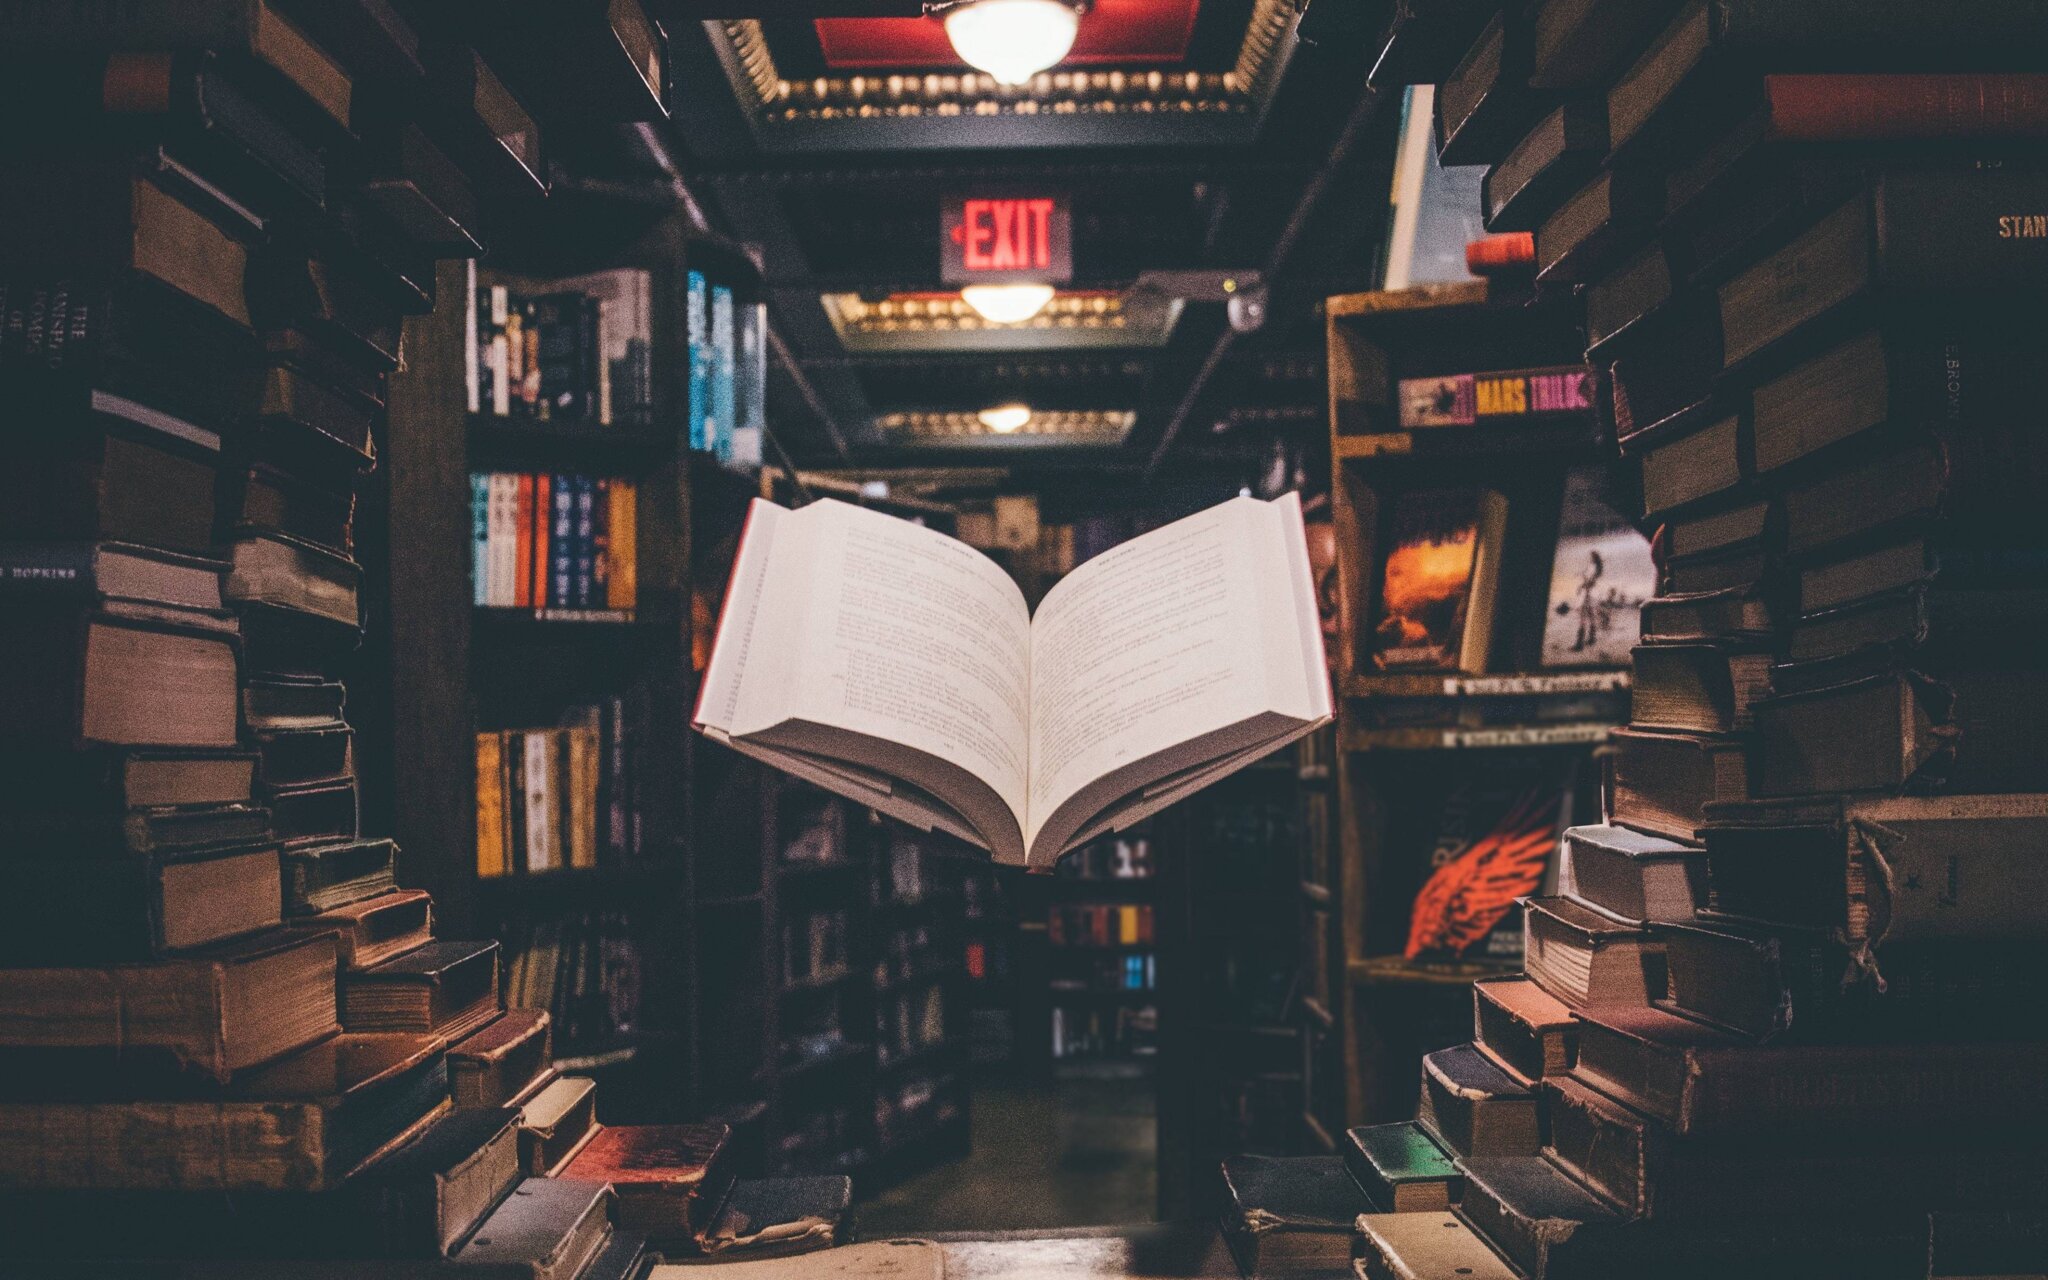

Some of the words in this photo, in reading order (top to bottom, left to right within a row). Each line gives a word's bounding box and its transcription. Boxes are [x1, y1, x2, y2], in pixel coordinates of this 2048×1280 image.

[965, 198, 1054, 270] EXIT
[1999, 215, 2048, 238] STAN
[71, 306, 88, 341] THE
[1476, 378, 1526, 415] MARS
[12, 567, 77, 579] HOPKINS
